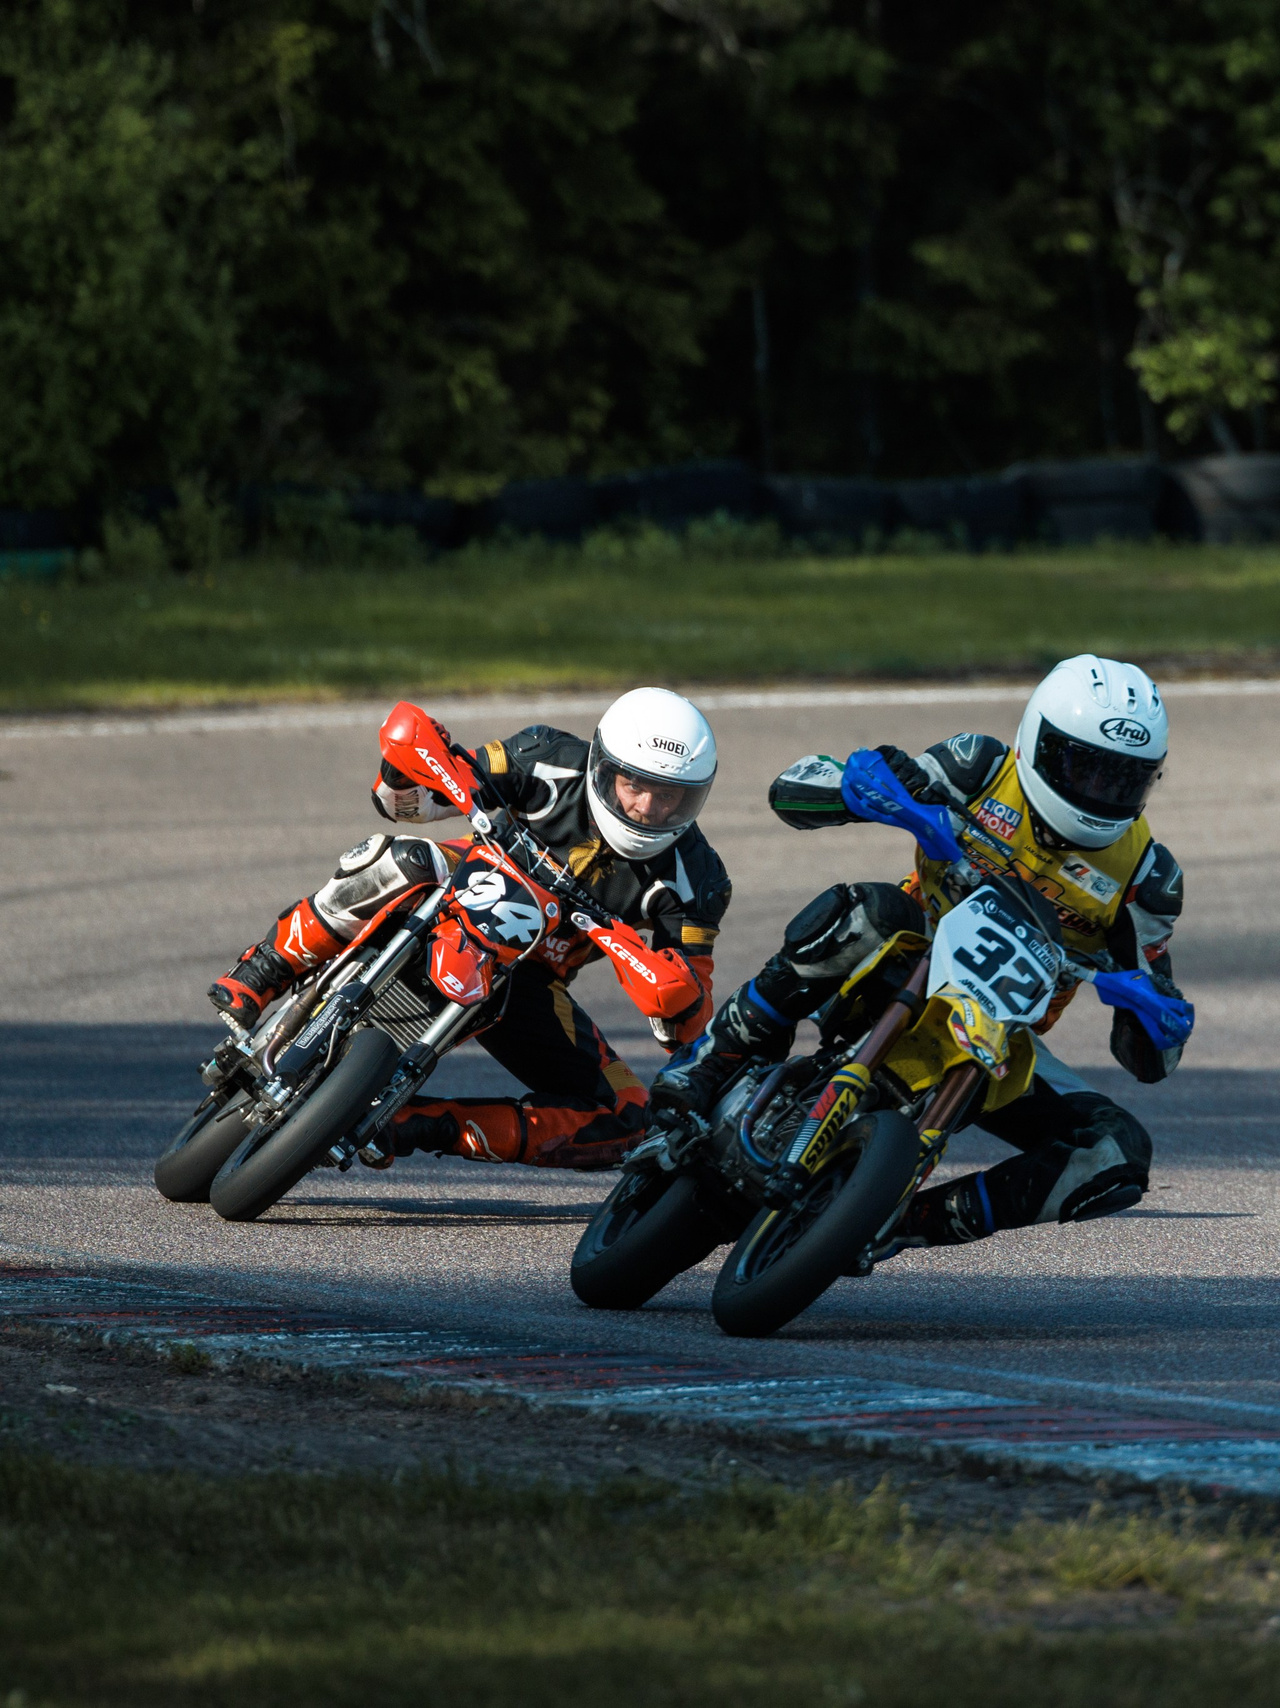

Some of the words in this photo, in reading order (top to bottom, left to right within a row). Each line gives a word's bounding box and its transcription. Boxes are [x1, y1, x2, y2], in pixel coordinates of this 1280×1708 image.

[1104, 720, 1146, 741] Arai
[652, 737, 685, 756] SHOEI
[976, 809, 1017, 839] MOLY
[983, 798, 1021, 826] LIQUI
[971, 829, 1012, 856] MICHIN
[953, 926, 1046, 1016] 32
